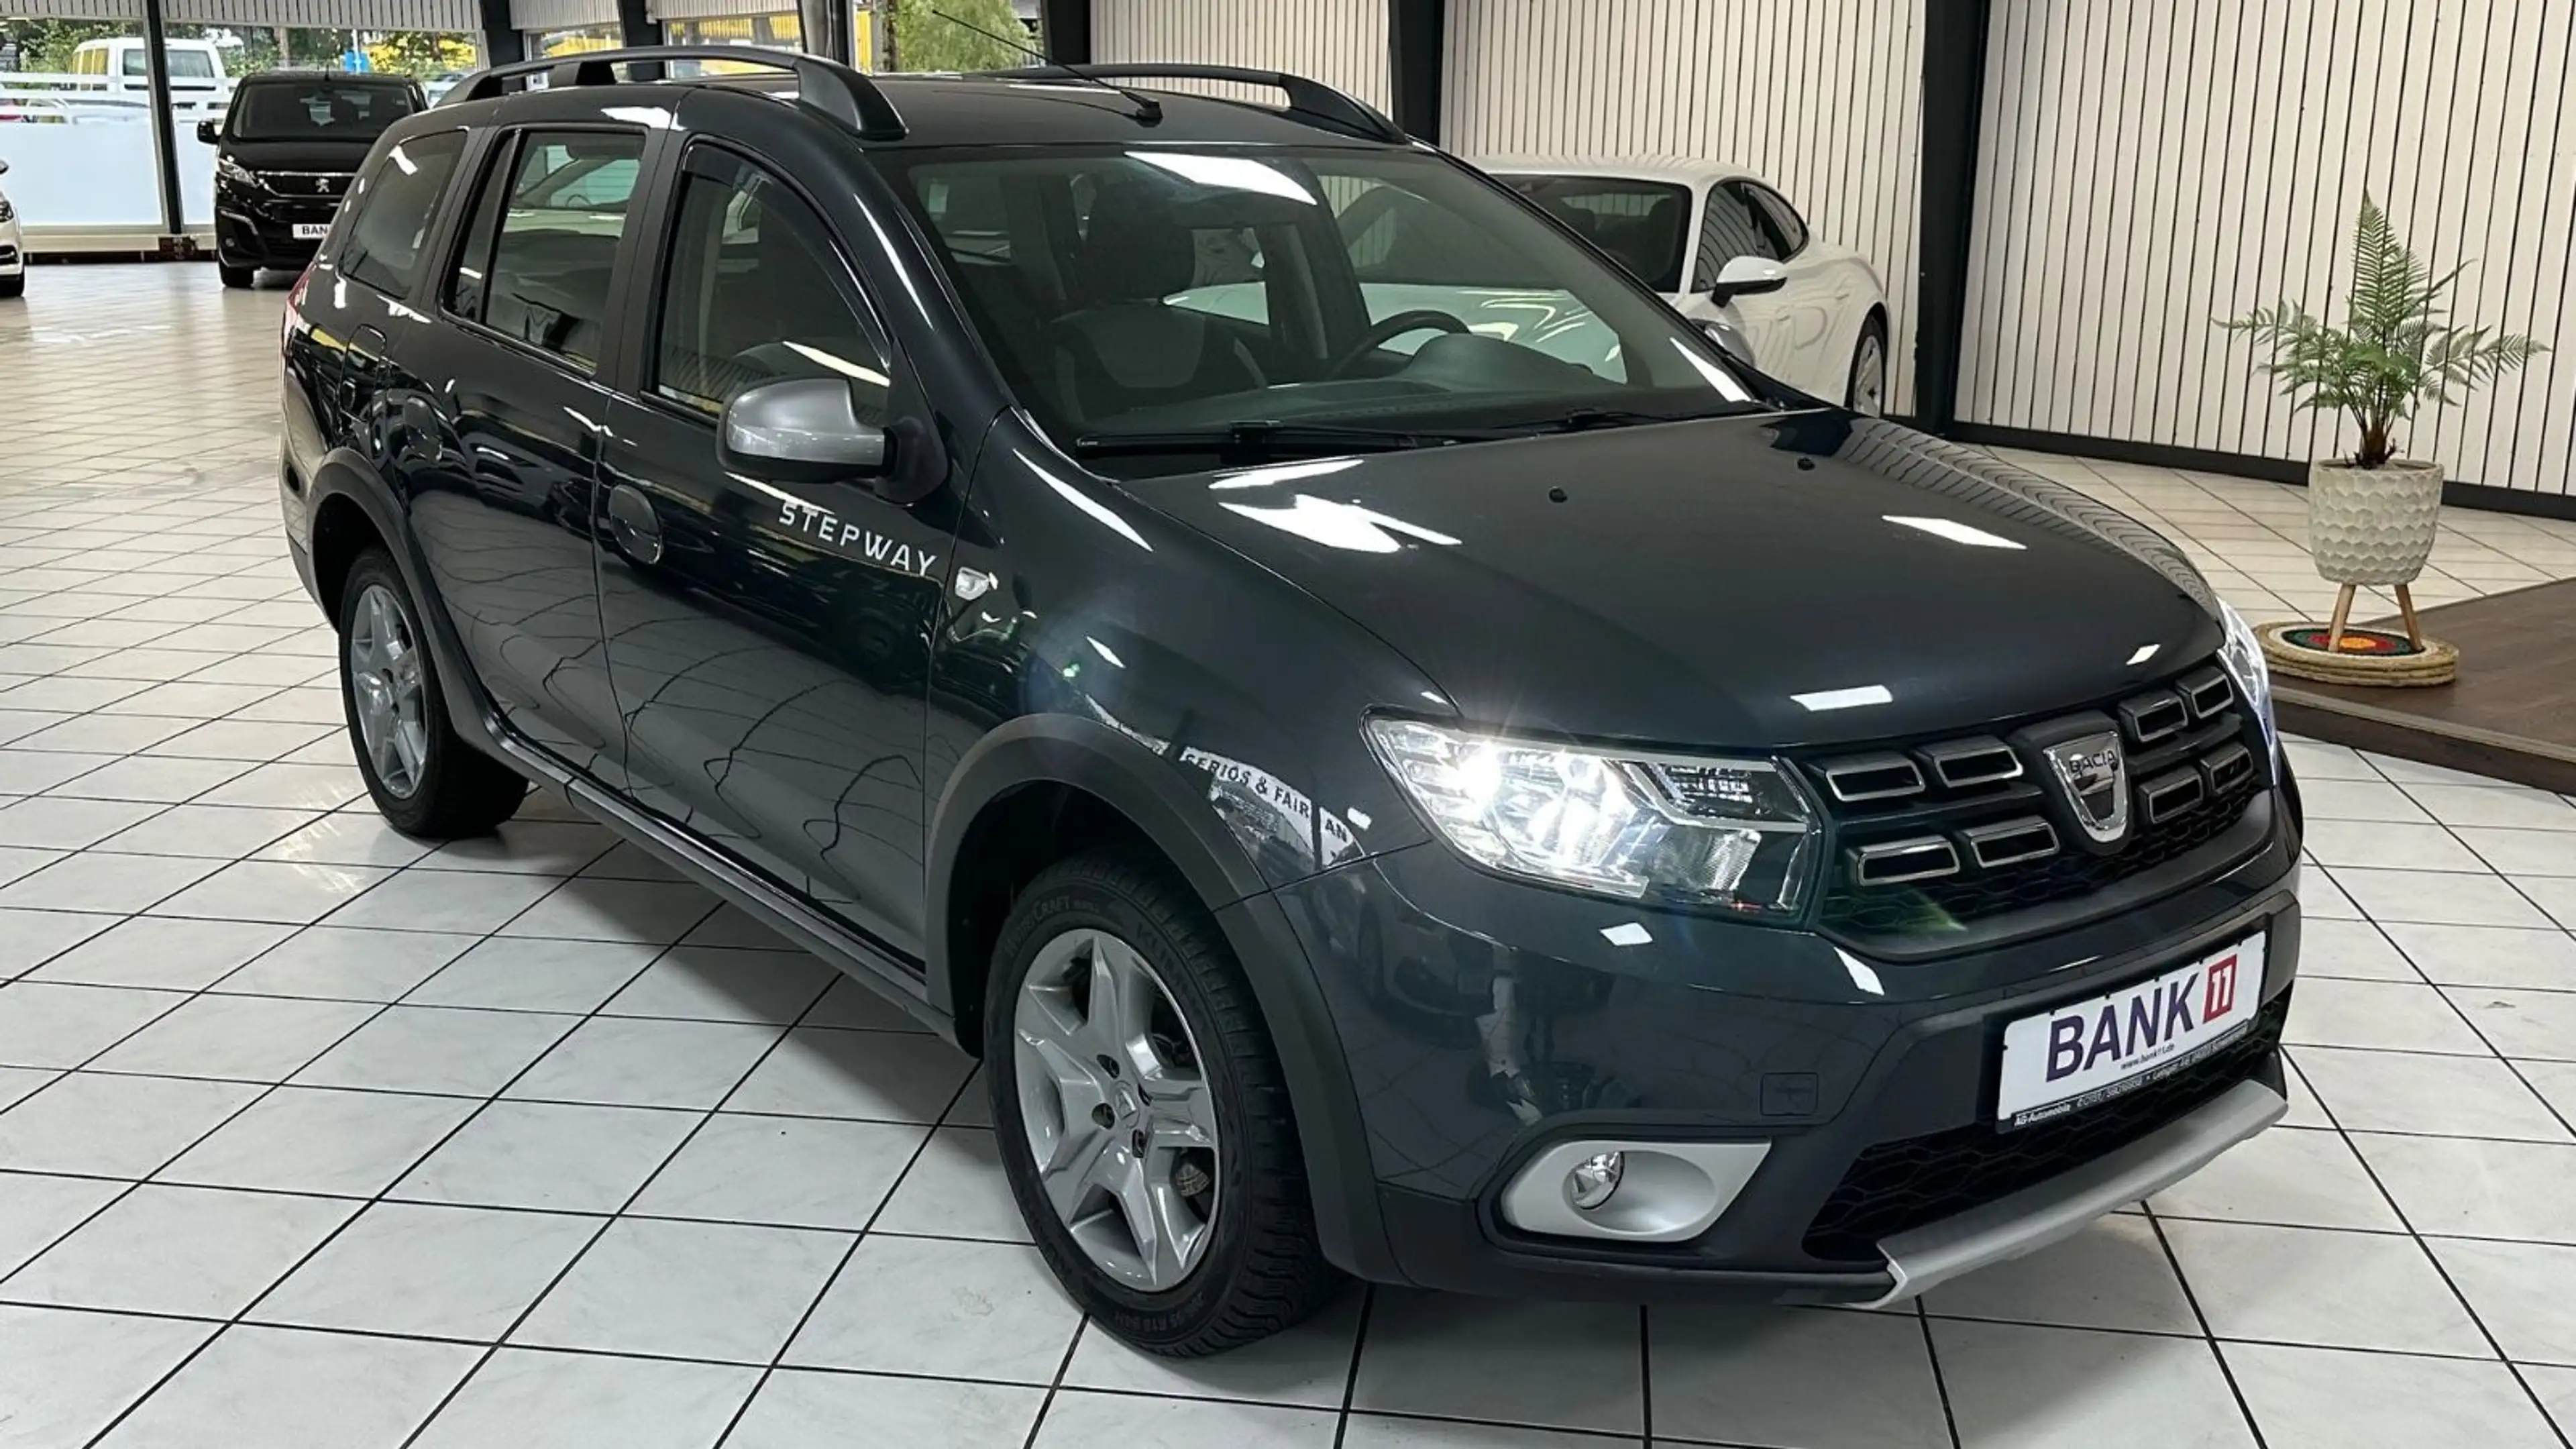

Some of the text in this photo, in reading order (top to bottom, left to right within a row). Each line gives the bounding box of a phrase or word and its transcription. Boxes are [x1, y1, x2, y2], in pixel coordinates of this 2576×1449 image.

[779, 500, 938, 576] STEPWAY
[2069, 750, 2116, 773] DACIA
[1274, 786, 1309, 818] FAIR
[2045, 971, 2200, 1083] BANK
[2208, 961, 2235, 1016] 11
